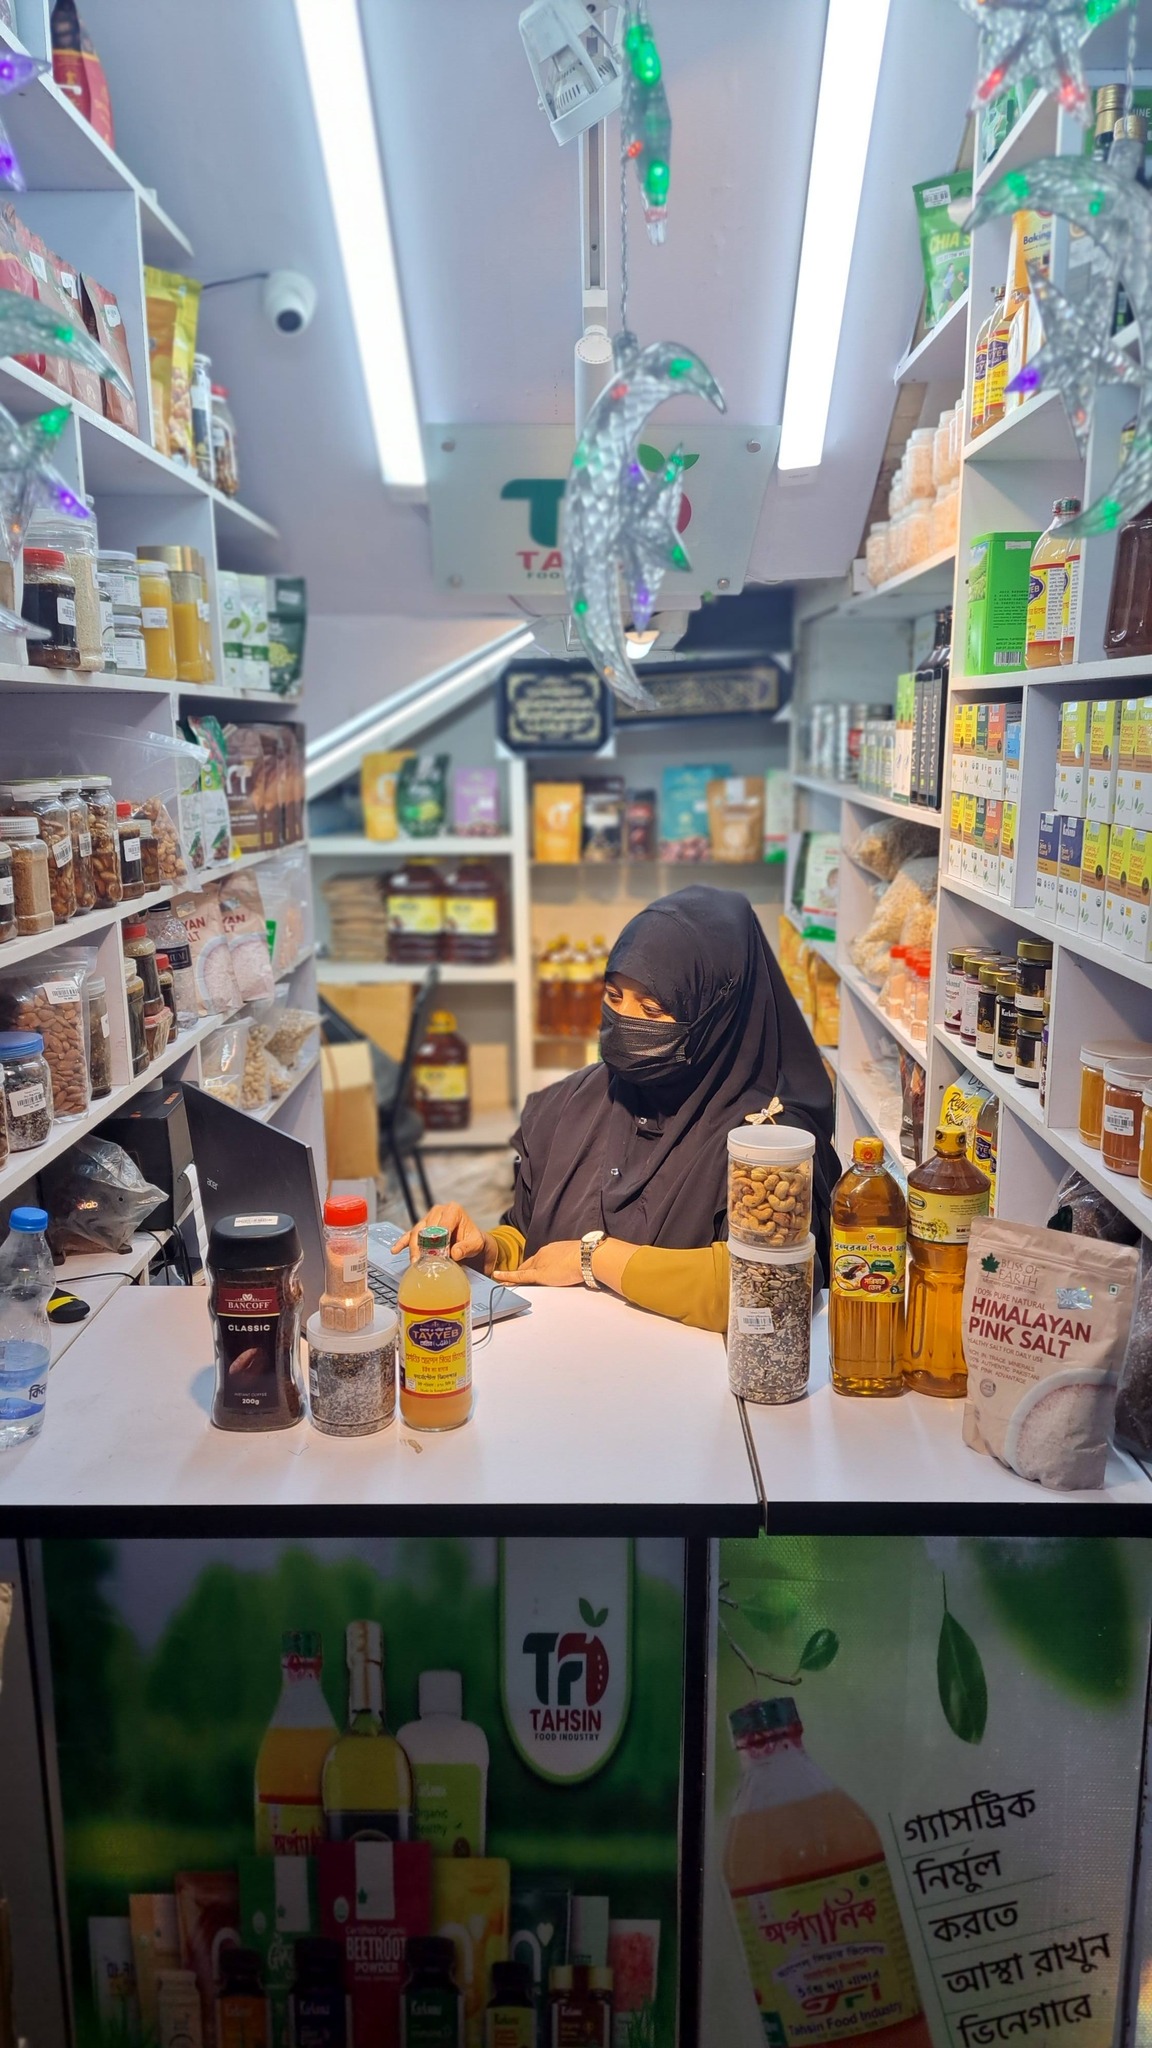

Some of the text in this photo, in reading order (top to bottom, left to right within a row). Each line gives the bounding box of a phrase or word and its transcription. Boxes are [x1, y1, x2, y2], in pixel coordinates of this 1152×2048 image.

[1001, 1258, 1040, 1275] BLISS OF
[998, 1269, 1038, 1288] EARTH
[975, 1287, 1046, 1309] 100% PURE NATURAL
[228, 1324, 270, 1332] CLASSIC
[971, 1295, 1092, 1344] HIMALAYAN
[412, 1329, 459, 1340] TAYYEB
[969, 1315, 1071, 1359] PINK SALT
[1015, 1349, 1031, 1360] DAILY
[981, 1360, 1011, 1372] AUTHENTIC
[529, 1709, 601, 1732] TAHSIN
[534, 1733, 600, 1741] FOOD INDUSTRY
[928, 1901, 1018, 1942] করতে
[345, 1926, 406, 1938] Certified Organic
[346, 1936, 407, 1960] BEETROOT
[354, 1961, 399, 1974] POWDER
[942, 1933, 1111, 1993] আস্থা রাখুন
[789, 2022, 825, 2036] Tahsin
[826, 2013, 857, 2030] Food
[859, 2001, 903, 2021] Industry
[957, 1994, 1093, 2048] ভিনেগারে
